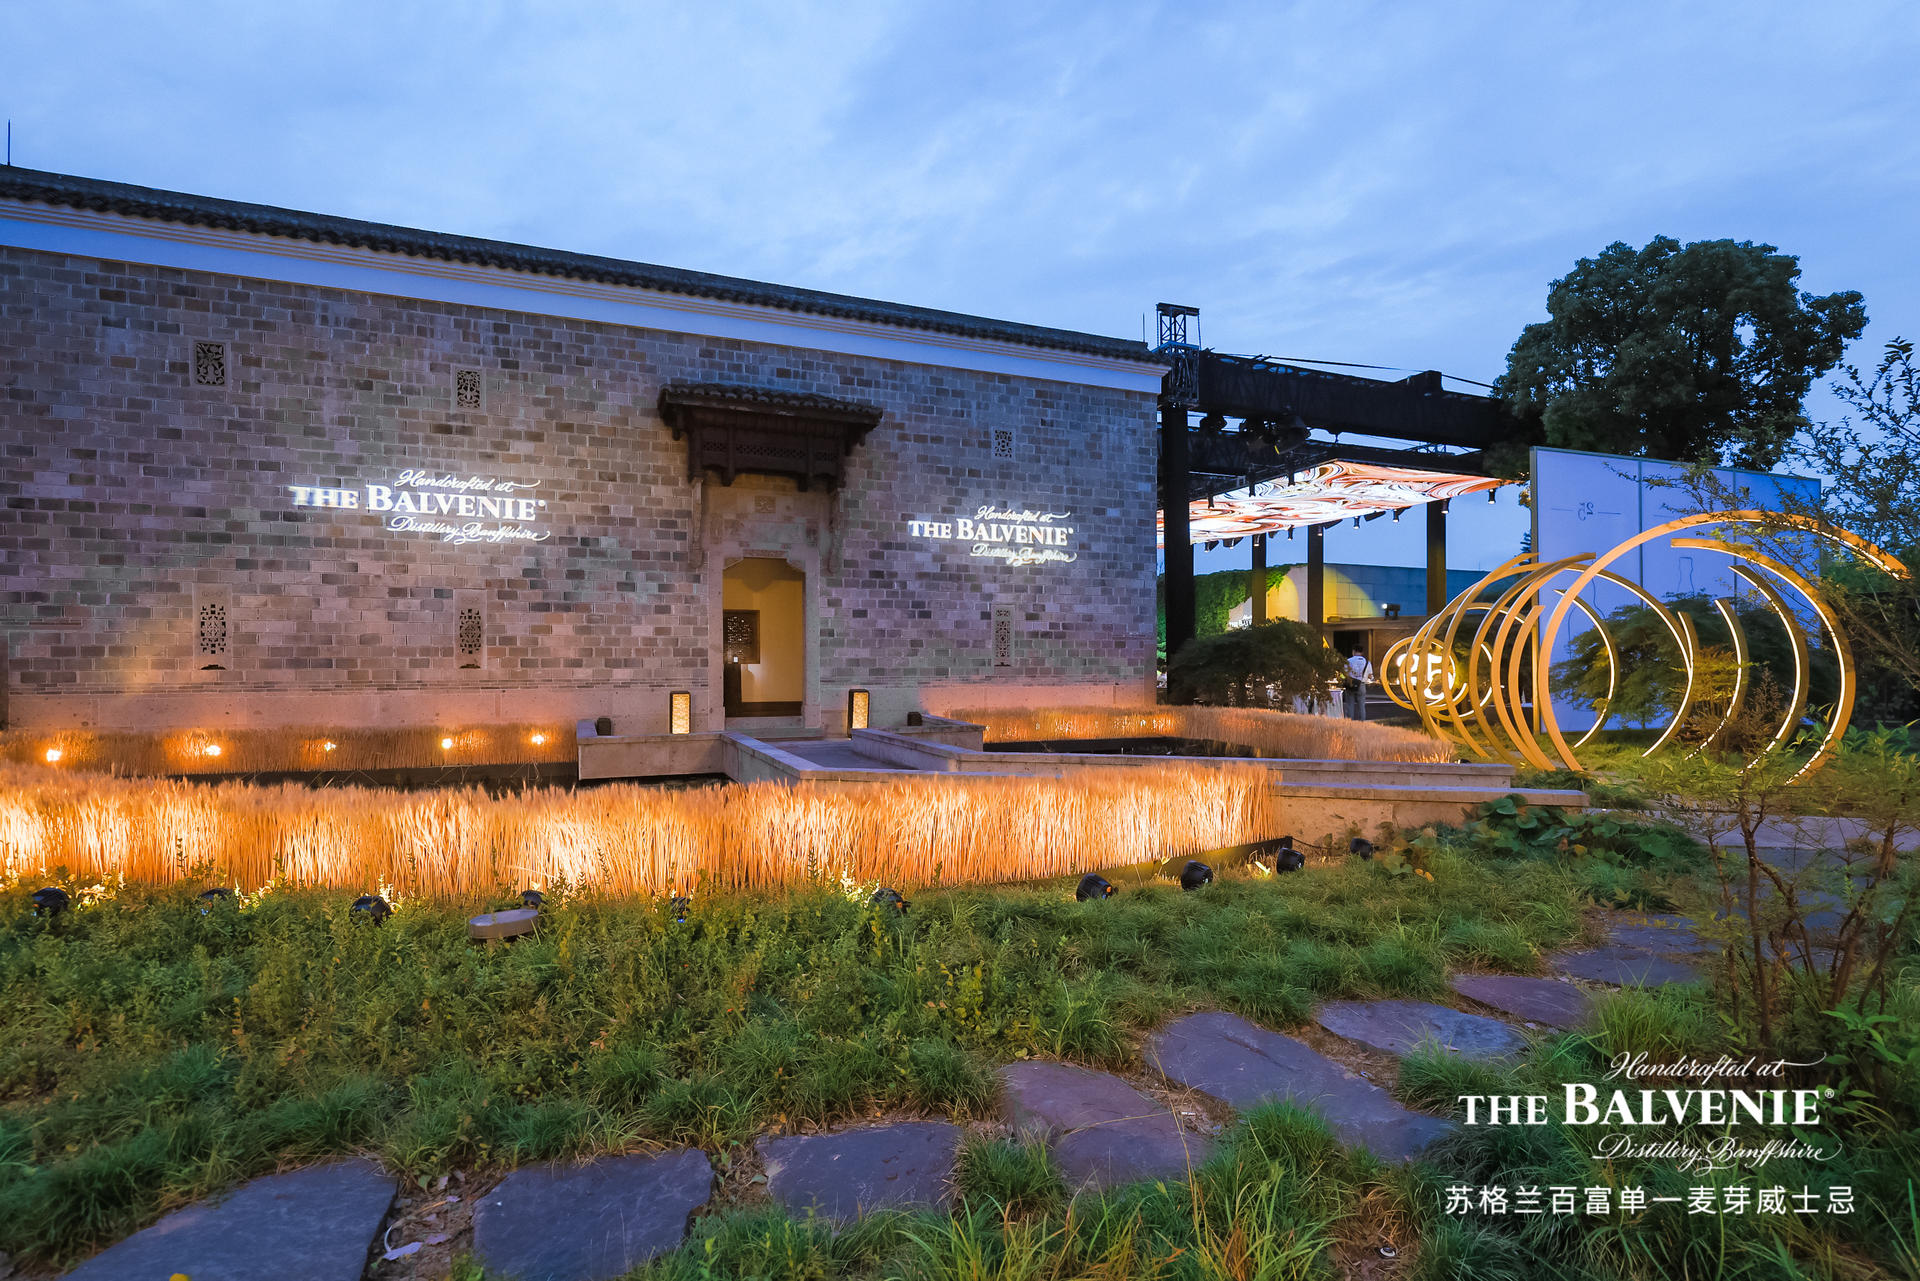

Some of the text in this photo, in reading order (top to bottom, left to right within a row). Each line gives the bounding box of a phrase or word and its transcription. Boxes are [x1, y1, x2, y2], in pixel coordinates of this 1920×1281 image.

[394, 469, 492, 494] Handcrafted
[289, 485, 359, 510] THE
[908, 520, 952, 539] THE
